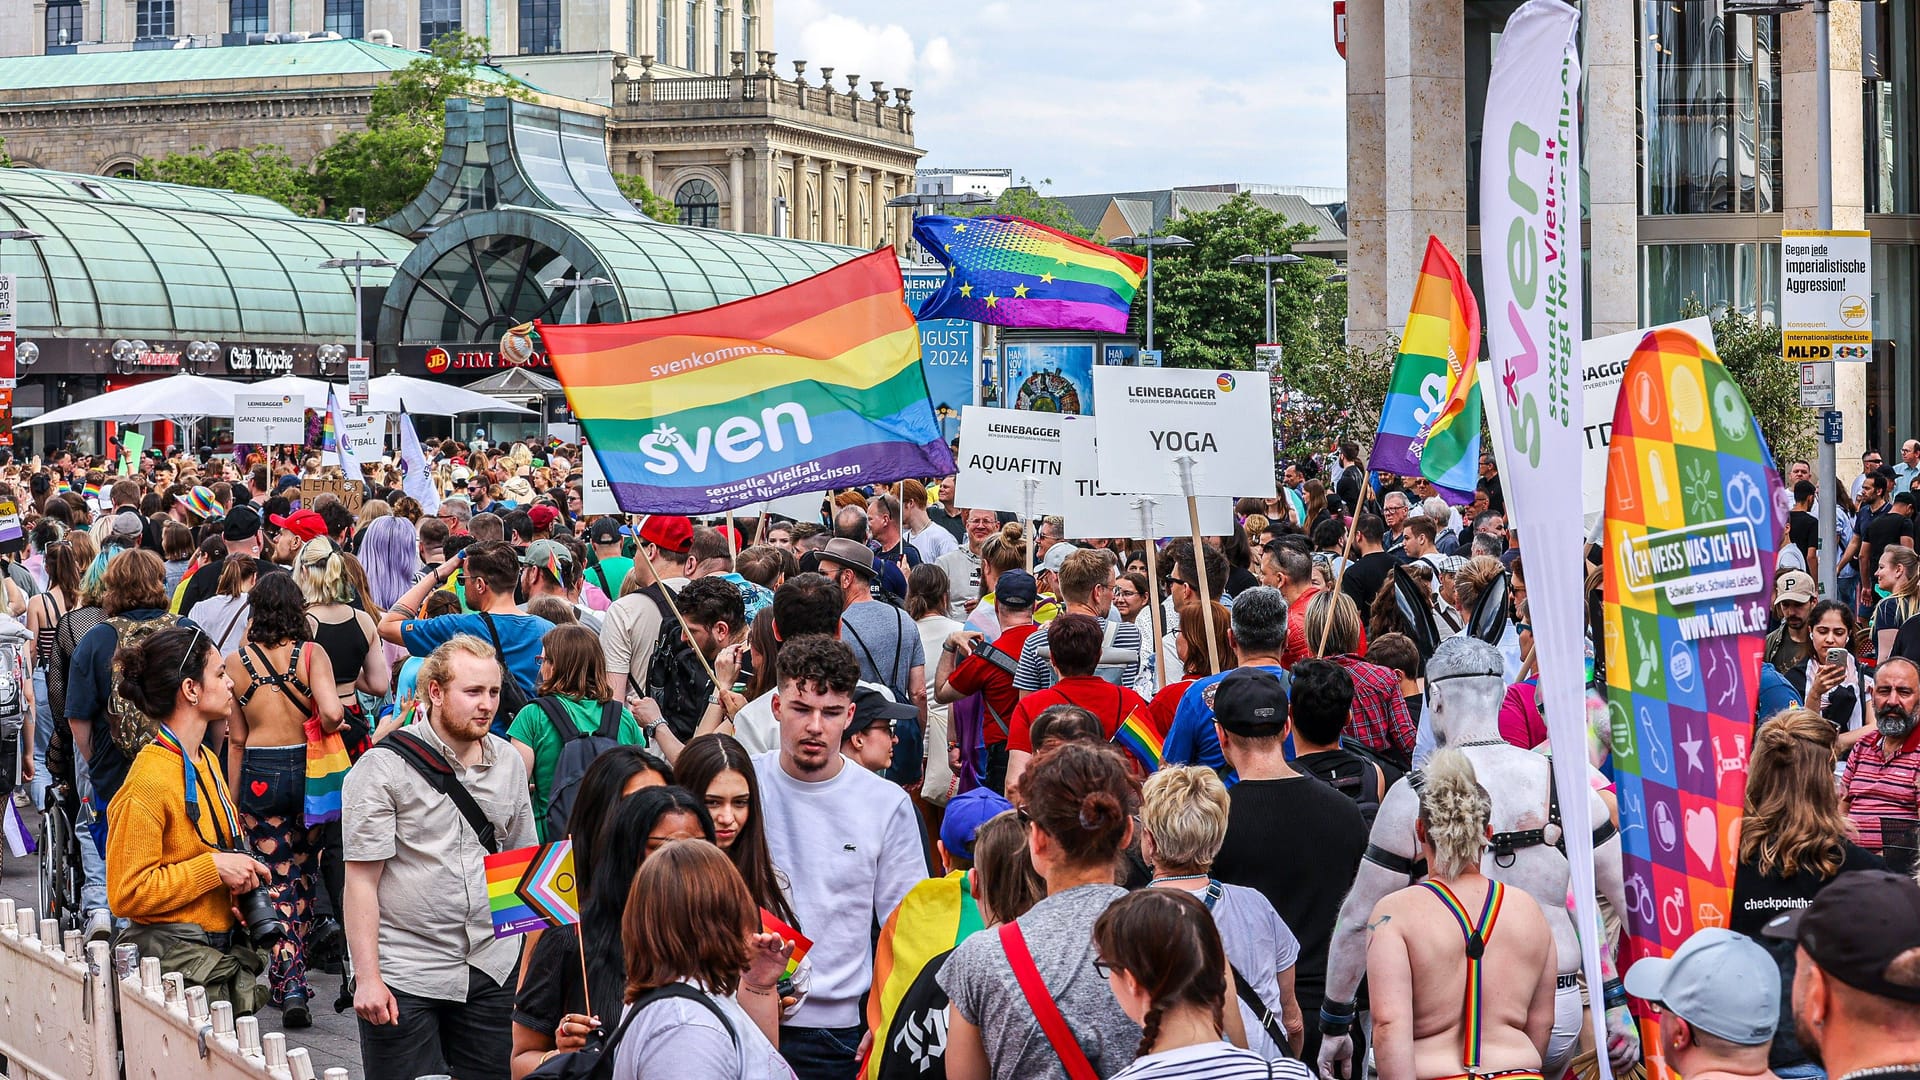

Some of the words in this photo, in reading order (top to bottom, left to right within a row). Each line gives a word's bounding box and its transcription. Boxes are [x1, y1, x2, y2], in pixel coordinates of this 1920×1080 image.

[1785, 244, 1810, 256] Gegen
[1811, 244, 1829, 256] jede
[1785, 258, 1866, 275] imperialistische
[1786, 277, 1846, 294] Aggression!
[1546, 274, 1557, 421] sexuelle
[1787, 345, 1831, 359] MLPD
[230, 347, 252, 370] Café
[254, 347, 294, 374] Kröpcke
[453, 352, 494, 369] JIM
[649, 345, 786, 377] svenkommt.de
[929, 350, 969, 366] 2024
[1558, 320, 1572, 428] erregt
[1127, 386, 1216, 399] LEINEBAGGER
[272, 416, 303, 424] RENNRAD
[638, 402, 813, 475] sven
[988, 423, 1061, 438] LEINEBAGGER
[1149, 430, 1218, 452] YOGA
[969, 454, 1062, 476] AQUAFITN
[591, 480, 609, 488] LEI
[705, 478, 767, 497] sexuelle
[767, 461, 821, 485] Vielfalt
[1649, 542, 1684, 574] WEISS
[1682, 536, 1710, 568] WAS
[1709, 532, 1733, 563] ICH
[1730, 530, 1751, 560] TU
[1785, 579, 1796, 591] P
[1677, 601, 1768, 641] www.iwwit.de
